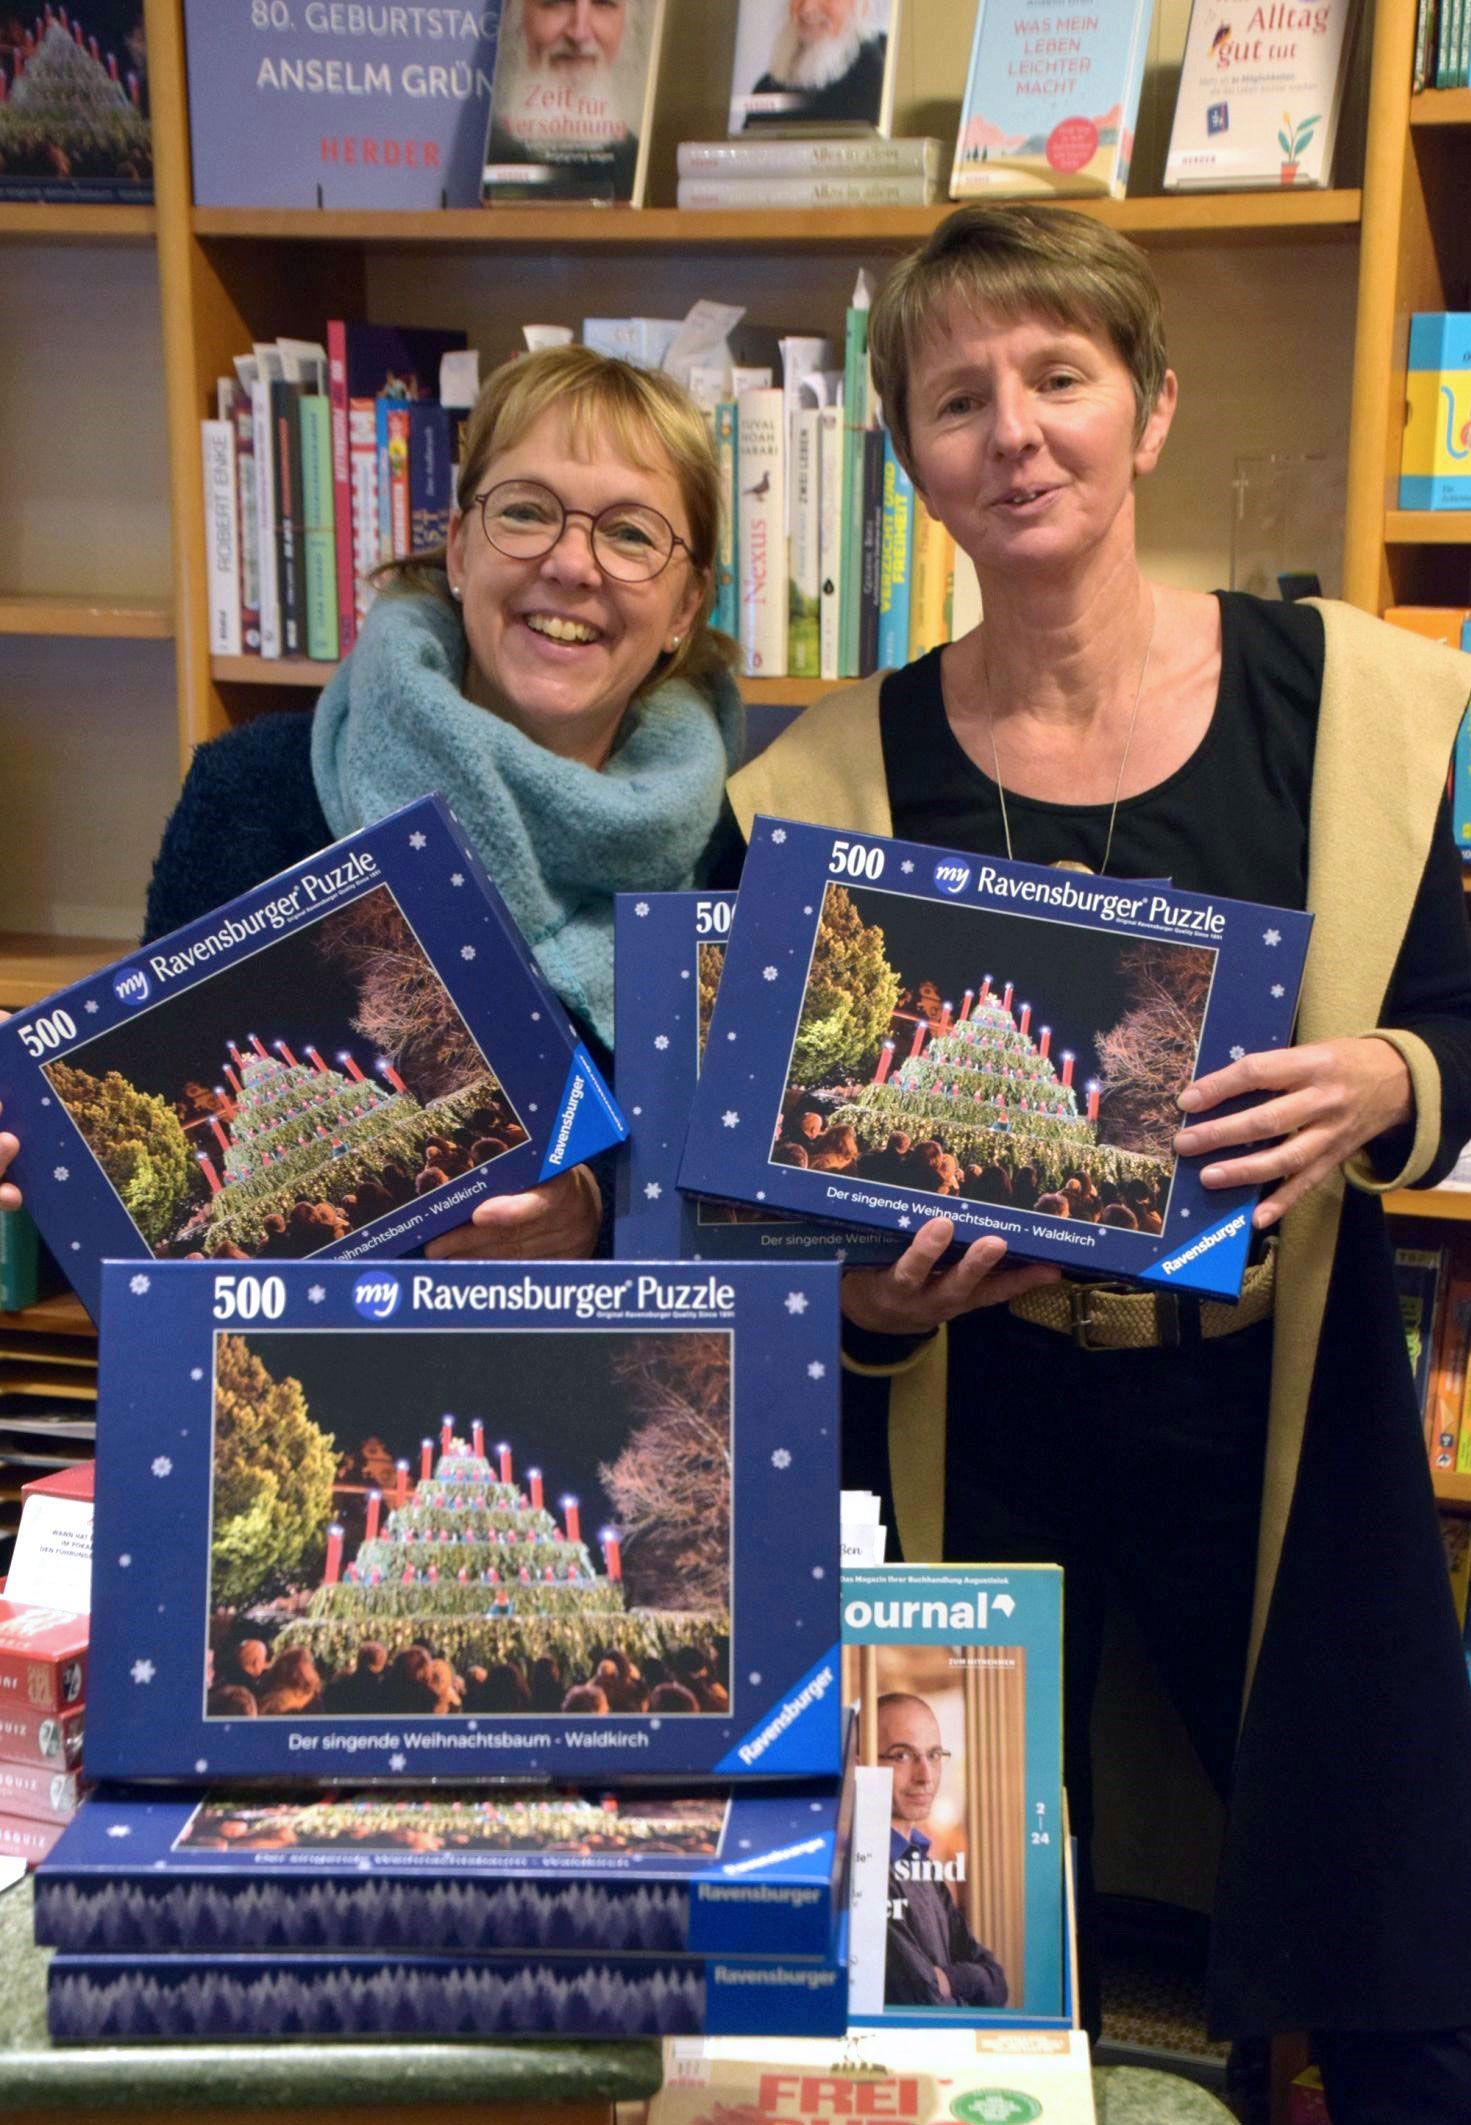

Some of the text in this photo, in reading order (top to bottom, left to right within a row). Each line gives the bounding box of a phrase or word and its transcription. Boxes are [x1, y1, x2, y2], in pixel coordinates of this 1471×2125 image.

[251, 1, 297, 32] 80.
[1014, 16, 1099, 35] WAS MEIN
[1248, 4, 1331, 33] Alltag
[1023, 37, 1081, 55] LEBEN
[1217, 40, 1297, 69] gut tut
[255, 56, 493, 100] ANSELM GRÜN
[1007, 57, 1091, 77] LEICHTER
[524, 83, 572, 108] Zeit
[1015, 78, 1077, 96] MACHT
[319, 135, 441, 170] HERDER
[799, 428, 809, 505] ZWEI LEBEN
[212, 434, 233, 574] ROBERT ENKE
[892, 494, 907, 584] FREIHEIT
[743, 517, 767, 606] Nexus
[828, 840, 885, 880] 500
[935, 862, 972, 894] my
[1148, 895, 1226, 934] Puzzle
[696, 901, 734, 934] 50
[17, 1008, 77, 1057] 500
[115, 970, 149, 1000] my
[300, 852, 377, 902] Puzzle
[548, 1074, 585, 1165] Ravensburger
[429, 1180, 488, 1216] Waldkirch
[826, 1186, 850, 1200] Der
[850, 1190, 910, 1213] singende
[911, 1201, 1022, 1233] Weihnachtsbaum
[1032, 1224, 1096, 1248] Waldkirch
[760, 1234, 783, 1247] Der
[785, 1232, 843, 1248] singende
[1160, 1213, 1247, 1276] Ravensburger
[212, 1275, 287, 1320] 500
[355, 1281, 400, 1318] my
[637, 1275, 735, 1310] Puzzle
[855, 1576, 887, 1585] Magazin
[908, 1576, 963, 1586] Buchhandlung
[840, 1591, 988, 1630] ournal
[738, 1665, 834, 1766] Ravensburger
[288, 1733, 320, 1750] Der
[321, 1732, 400, 1753] singende
[402, 1732, 551, 1749] Weihnachtsbaum
[564, 1731, 649, 1749] Waldkirch
[1035, 1802, 1046, 1815] 2
[1030, 1832, 1050, 1845] 24
[893, 1851, 967, 1882] sind
[698, 1883, 821, 1906] Ravensburger
[714, 1965, 837, 1989] Ravensburger
[758, 2073, 919, 2117] FREI
